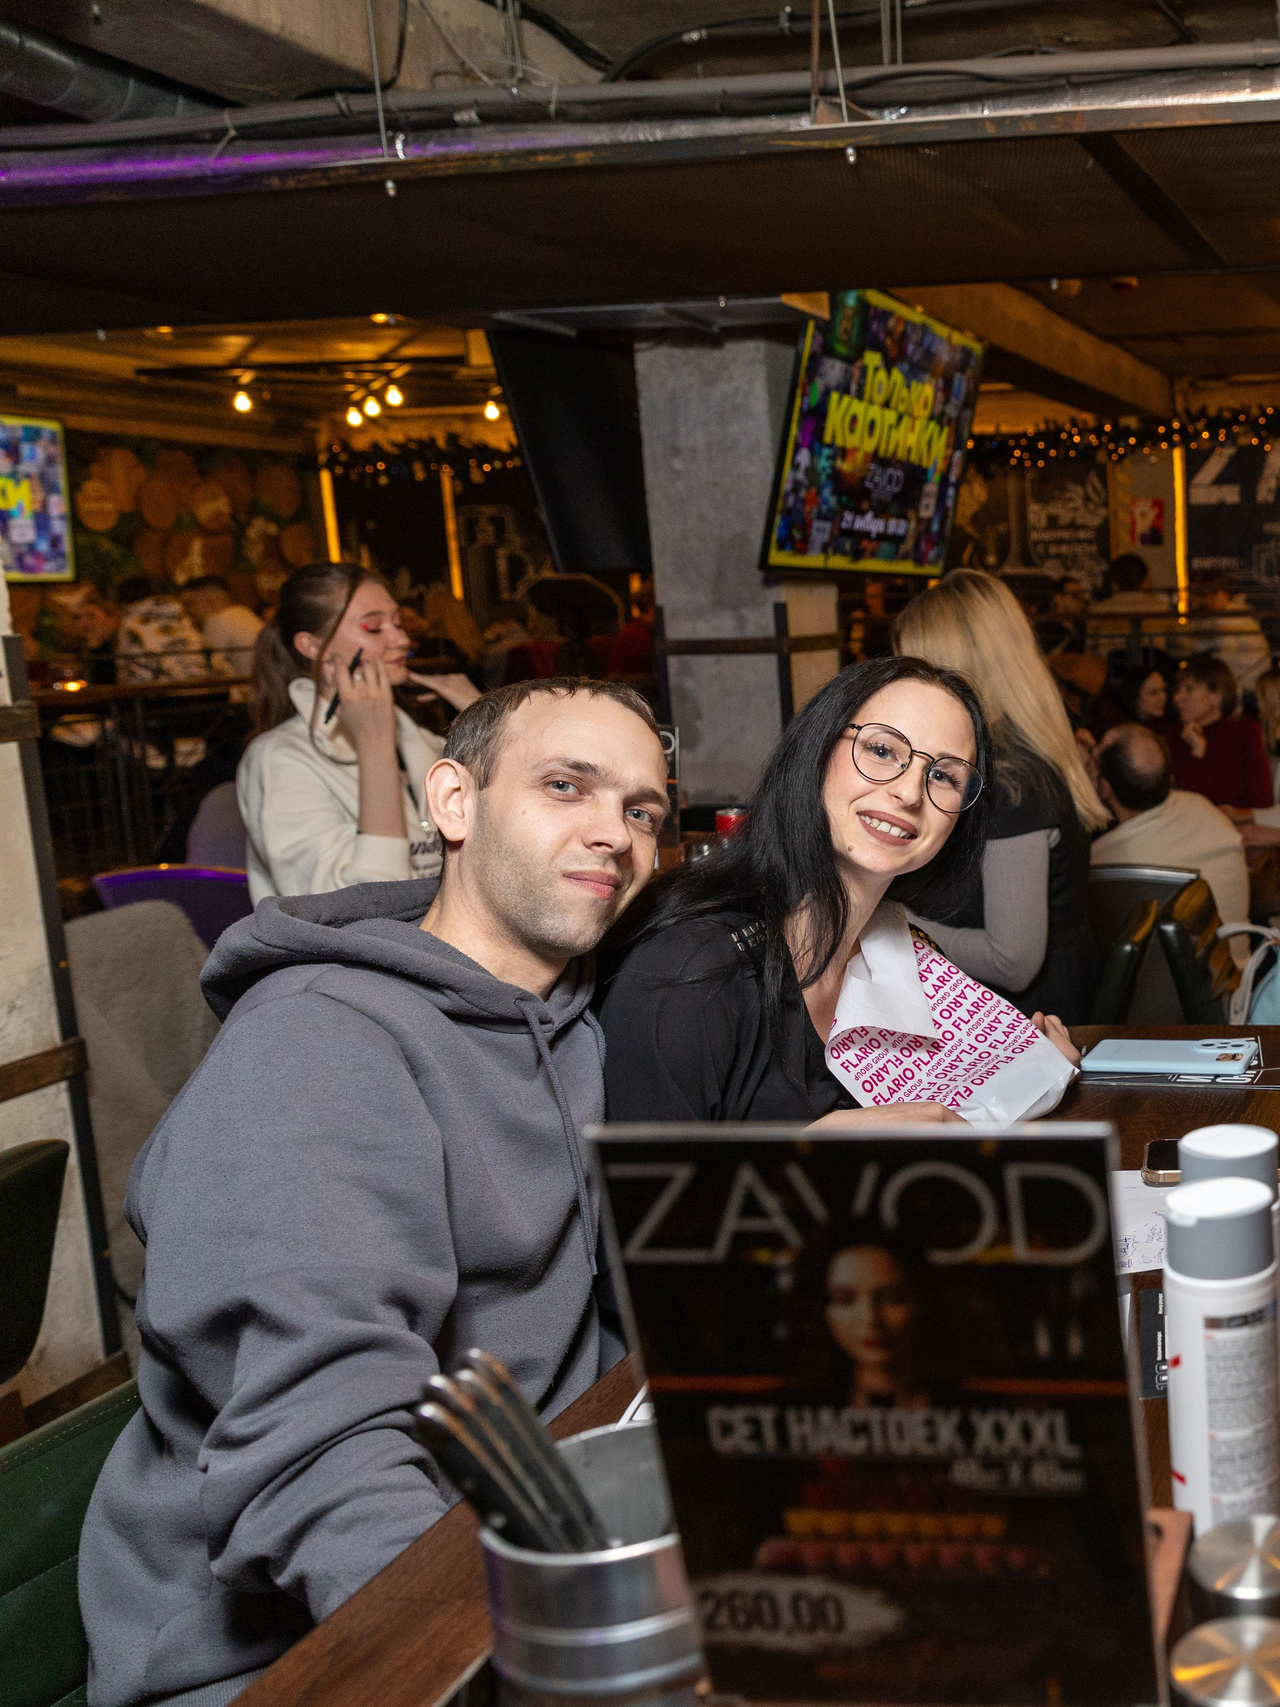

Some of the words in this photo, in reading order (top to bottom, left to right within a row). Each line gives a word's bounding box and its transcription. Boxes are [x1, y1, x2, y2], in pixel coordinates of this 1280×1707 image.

[917, 954, 948, 984] FLAR
[923, 964, 961, 1001] LARIO
[930, 990, 952, 1013] GROUP
[938, 979, 983, 1021] FLARIO
[982, 999, 1002, 1019] GROUP
[965, 1016, 986, 1037] GROUP
[973, 1003, 1017, 1044] FLARIO
[829, 1025, 871, 1061] FLARIO
[839, 1036, 883, 1075] FLARIO
[871, 1066, 916, 1107] FLARIO
[911, 1029, 956, 1072] FLARIO
[950, 989, 995, 1033] FLARIO
[871, 1047, 890, 1065] GROUP
[943, 1037, 964, 1059] GROUP
[947, 1050, 993, 1090] FLARIO
[985, 1011, 1029, 1051] FLARIO
[854, 1062, 874, 1081] GROUP
[860, 1053, 905, 1094] FLARIO
[925, 1057, 946, 1078] GROUP
[933, 1042, 979, 1086] FLARIO
[969, 1046, 1015, 1087] FLARIO
[902, 1078, 924, 1098] GROUP
[605, 1161, 1107, 1265] ZAVOD
[706, 1405, 779, 1455] СЕТ
